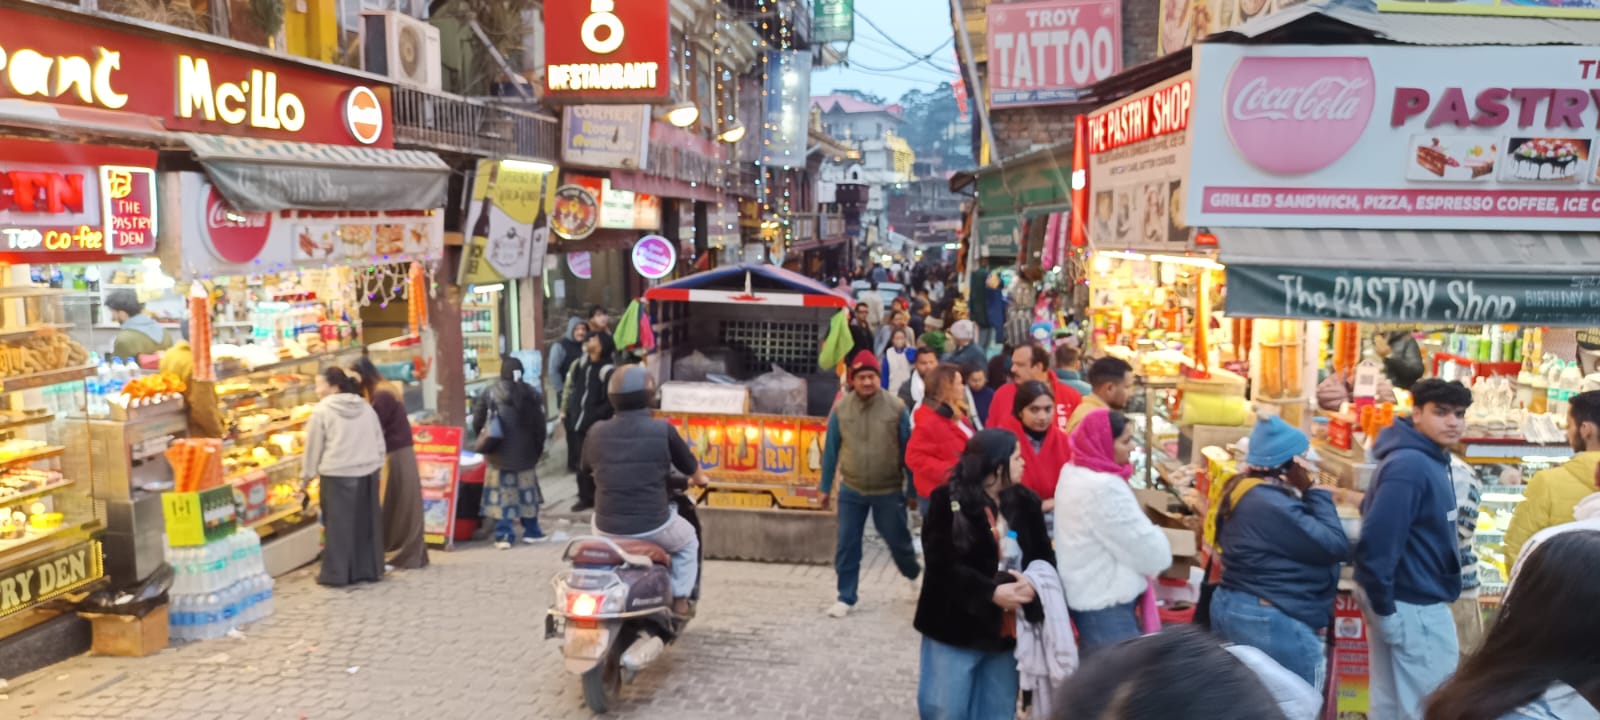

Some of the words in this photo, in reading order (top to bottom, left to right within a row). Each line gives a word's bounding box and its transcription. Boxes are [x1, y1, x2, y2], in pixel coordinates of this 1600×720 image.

[1025, 8, 1079, 28] TROY
[994, 26, 1114, 87] TATTOO
[548, 61, 658, 90] RESTAURANT
[1231, 75, 1370, 121] Coca-Cola
[1088, 114, 1106, 153] THE
[1107, 96, 1149, 146] PASTRY
[1151, 80, 1191, 136] SHOP
[119, 200, 141, 213] THE
[1210, 192, 1271, 209] GRILLED
[1274, 194, 1360, 211] SANDWICH,
[1363, 195, 1412, 212] PIZZA,
[1415, 196, 1493, 211] ESPRESSO
[1497, 197, 1558, 213] COFFEE,
[1563, 198, 1588, 212] ICE
[111, 215, 152, 229] PASTRY
[119, 231, 144, 246] DEN
[1277, 274, 1328, 316] The
[1333, 275, 1437, 320] PASTRY
[1444, 279, 1517, 321] Shop
[1525, 289, 1584, 308] BIRTHDAY
[38, 550, 86, 595] DEN
